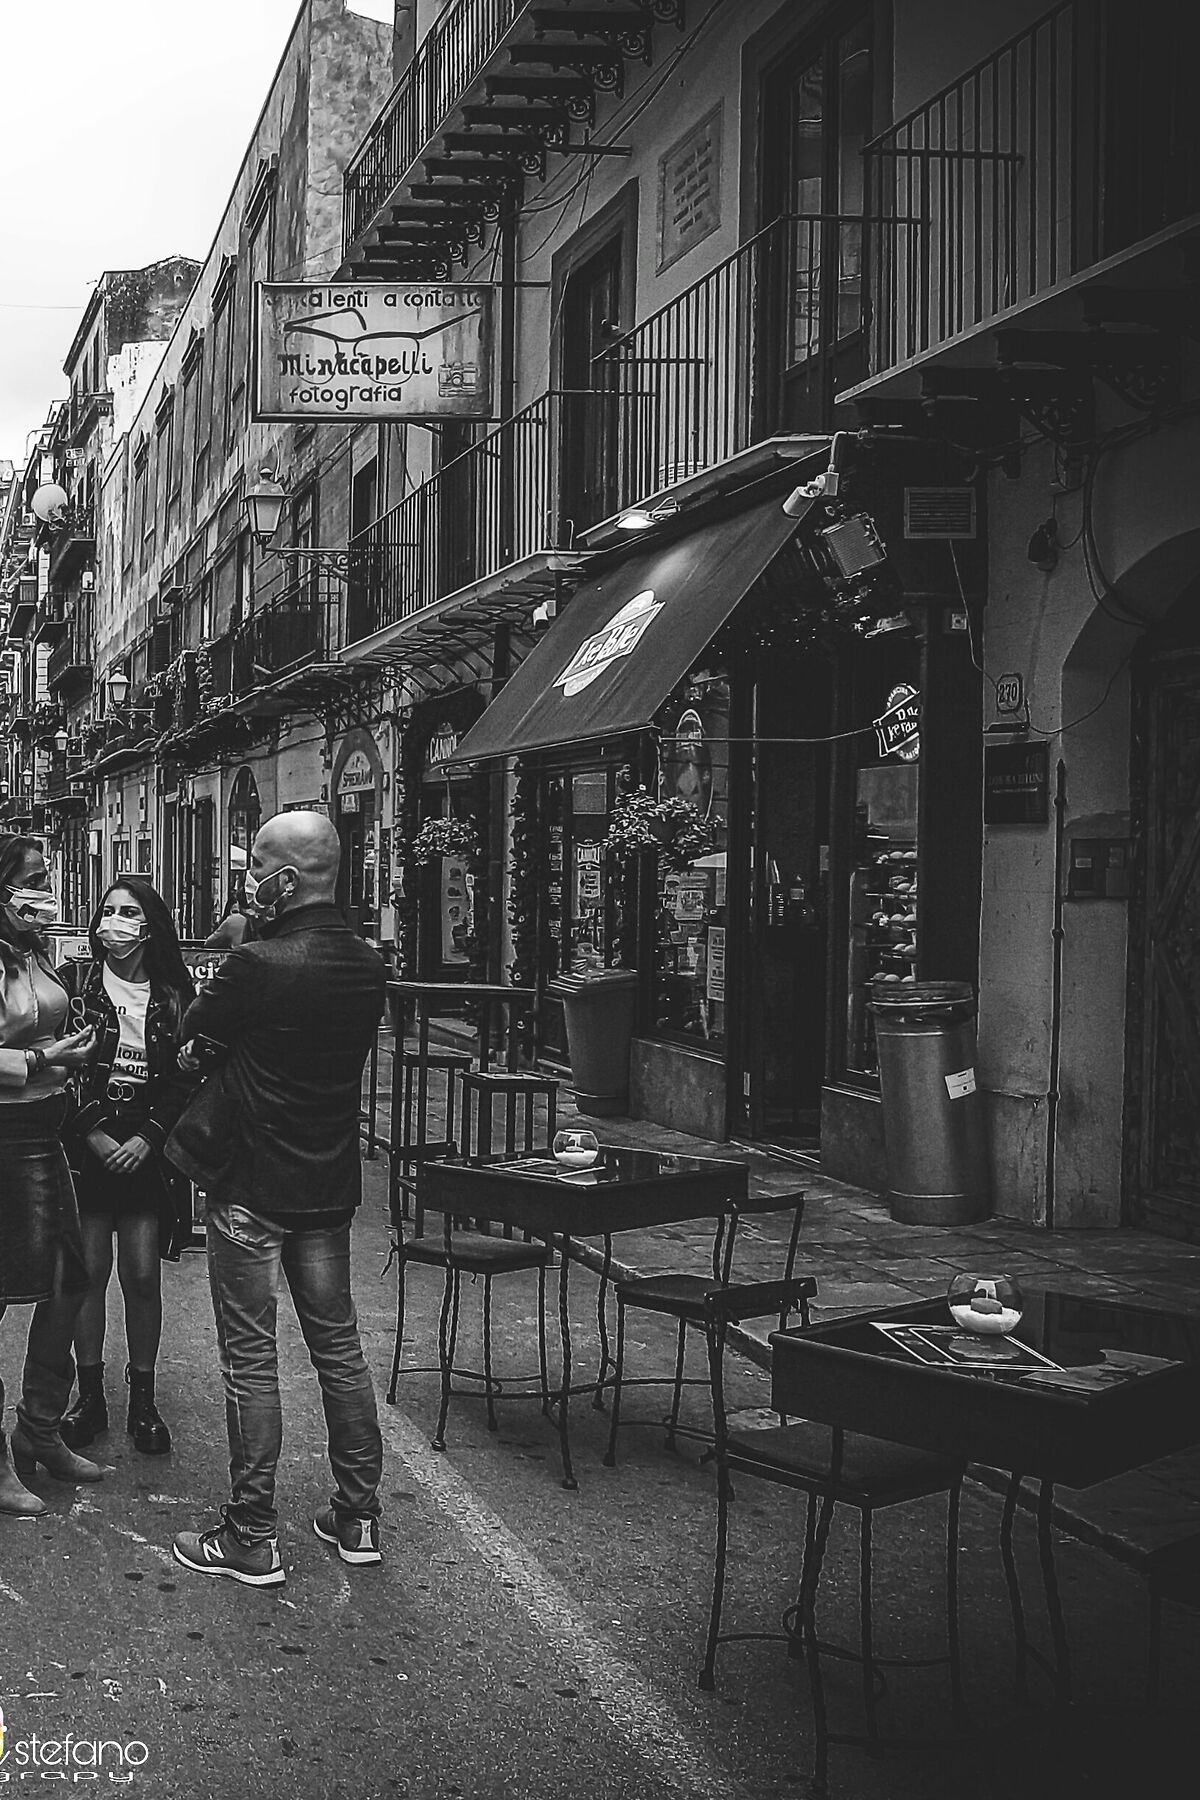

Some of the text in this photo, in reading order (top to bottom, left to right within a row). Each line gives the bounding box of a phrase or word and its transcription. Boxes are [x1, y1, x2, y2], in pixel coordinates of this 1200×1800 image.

[328, 289, 368, 308] lenti
[383, 293, 397, 307] a
[289, 386, 401, 411] fotografia
[999, 683, 1018, 703] 270
